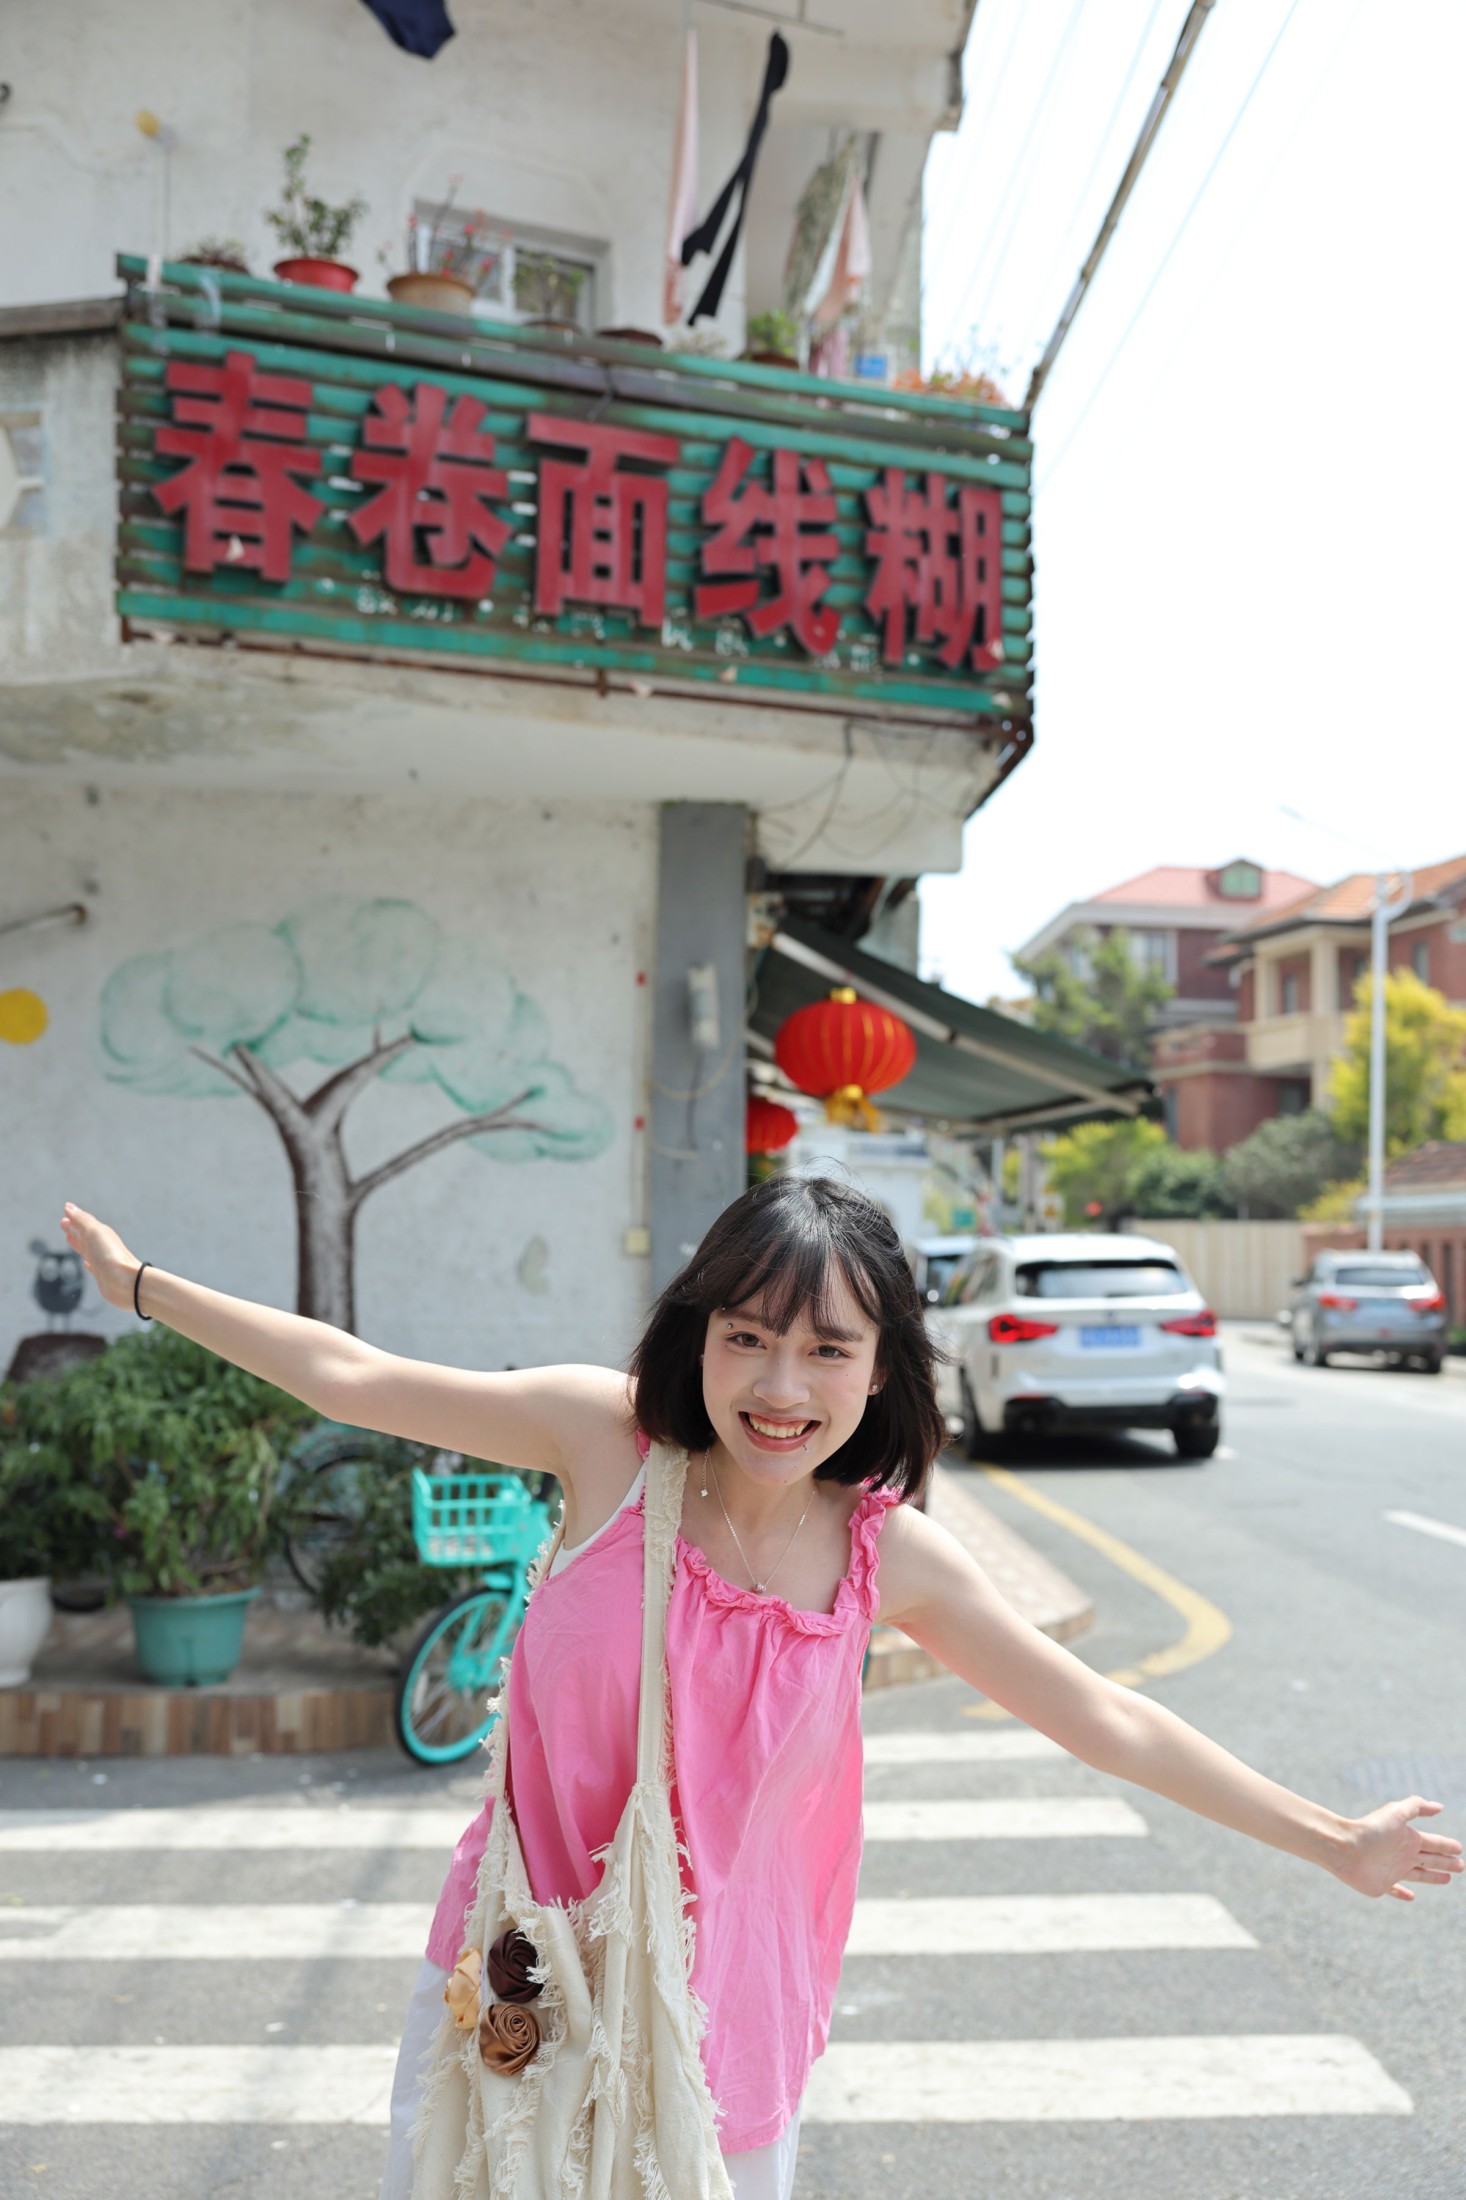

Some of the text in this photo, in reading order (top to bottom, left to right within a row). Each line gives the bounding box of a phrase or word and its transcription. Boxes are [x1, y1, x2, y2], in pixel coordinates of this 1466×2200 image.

[152, 352, 1003, 671] 春卷面线糊
